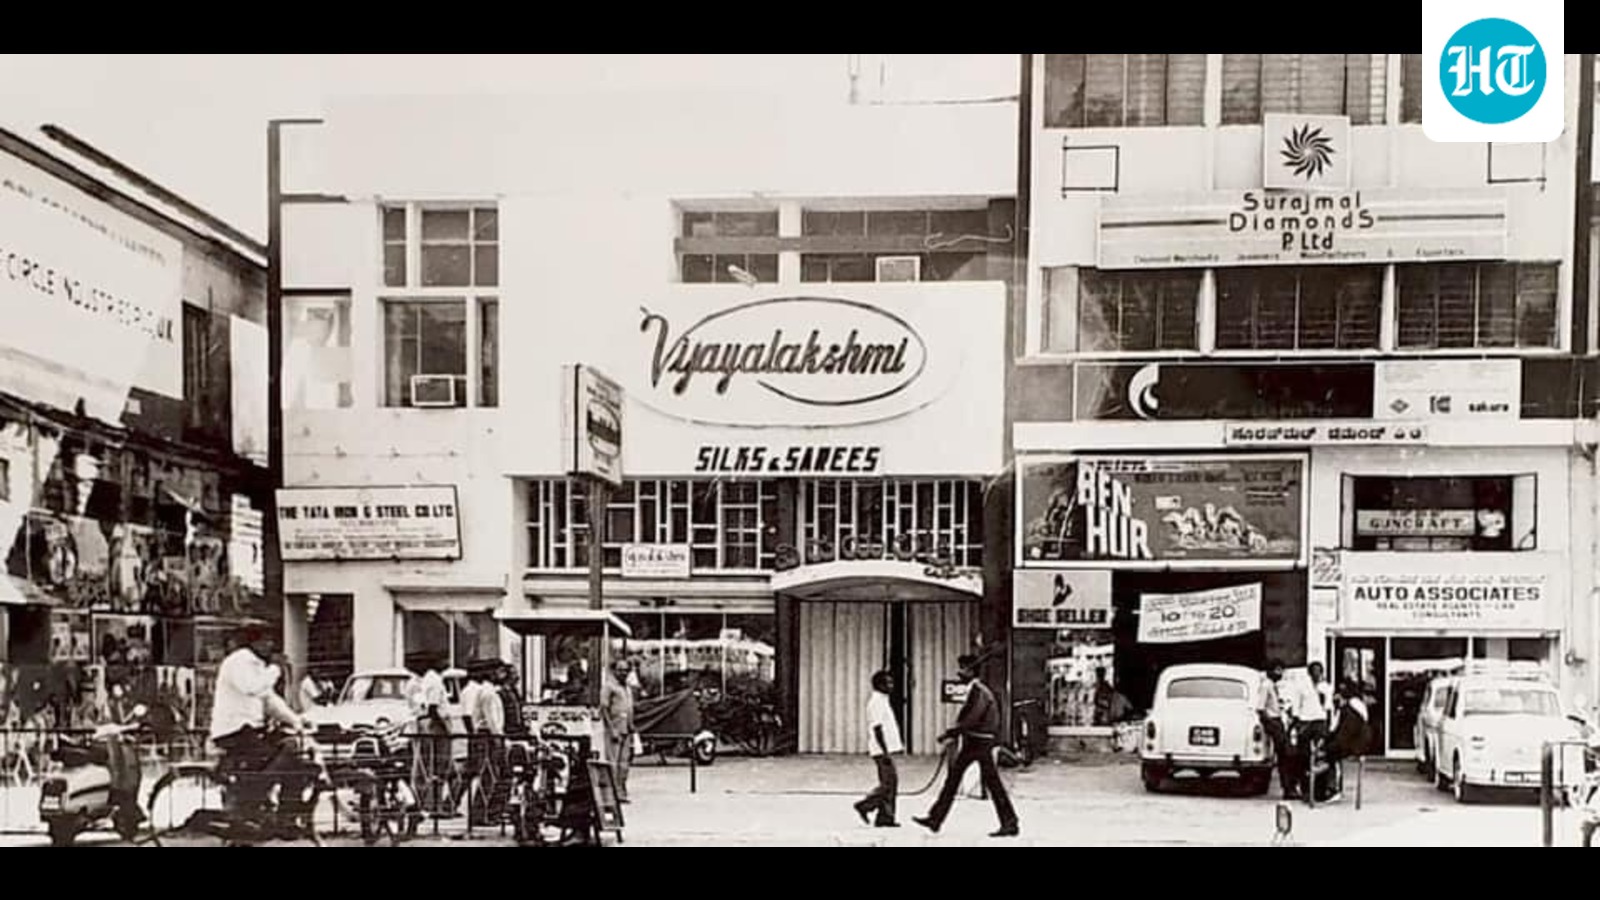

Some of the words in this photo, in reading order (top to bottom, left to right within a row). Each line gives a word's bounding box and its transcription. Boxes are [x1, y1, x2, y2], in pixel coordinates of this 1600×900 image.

[1243, 190, 1361, 215] Surajmal
[640, 306, 908, 395] Vijayalakshmi
[695, 447, 767, 471] SILKS
[768, 456, 781, 471] &
[783, 447, 880, 471] SAREES
[278, 506, 297, 519] THE
[303, 506, 329, 519] TATA
[334, 506, 358, 518] IRON
[376, 505, 411, 518] STEEL
[1086, 502, 1153, 558] HUR
[1354, 586, 1409, 601] AUTO
[1413, 586, 1541, 601] ASSOCIATES
[1017, 608, 1051, 623] SHOE
[1056, 608, 1108, 623] SELLER
